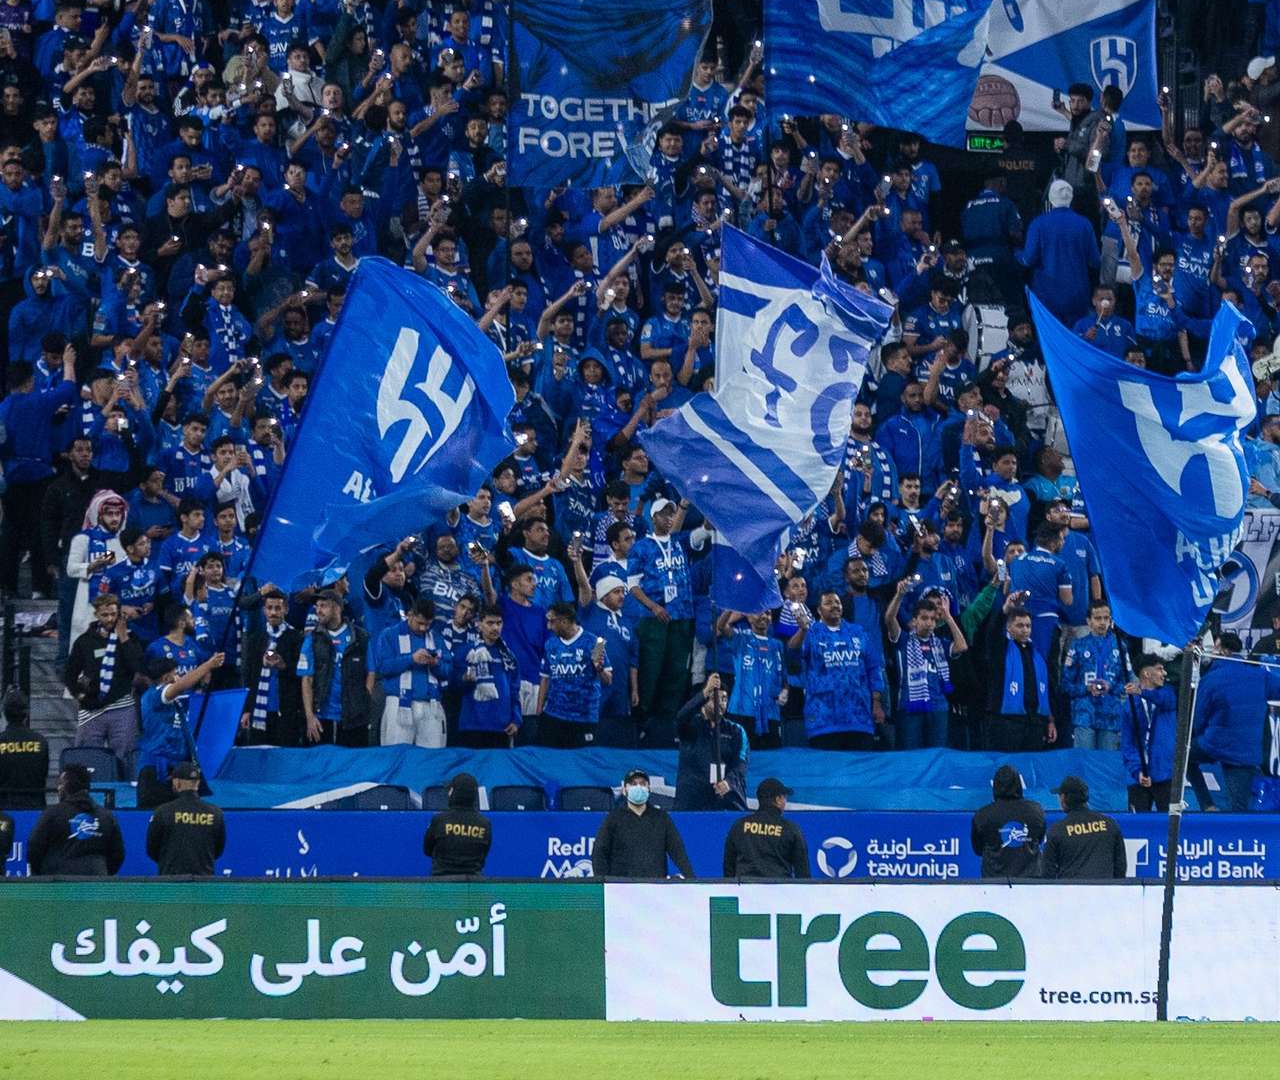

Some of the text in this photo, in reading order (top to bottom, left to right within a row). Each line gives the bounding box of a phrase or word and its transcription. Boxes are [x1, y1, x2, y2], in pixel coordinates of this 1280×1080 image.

[1147, 302, 1169, 317] SAV
[824, 651, 861, 663] SAVVY
[550, 664, 586, 676] SAVVY
[0, 740, 41, 755] POLICE
[175, 811, 214, 826] POLICE
[444, 823, 486, 838] POLICE
[743, 822, 783, 837] POLICE
[1066, 821, 1107, 836] POLICE
[547, 837, 585, 857] Red
[866, 861, 960, 881] tawuniya
[1158, 861, 1264, 881] Riyad Bank
[51, 919, 227, 994] كيفك
[250, 920, 366, 996] على
[710, 896, 1026, 1010] tree
[1040, 986, 1162, 1006] tree.com.sa
